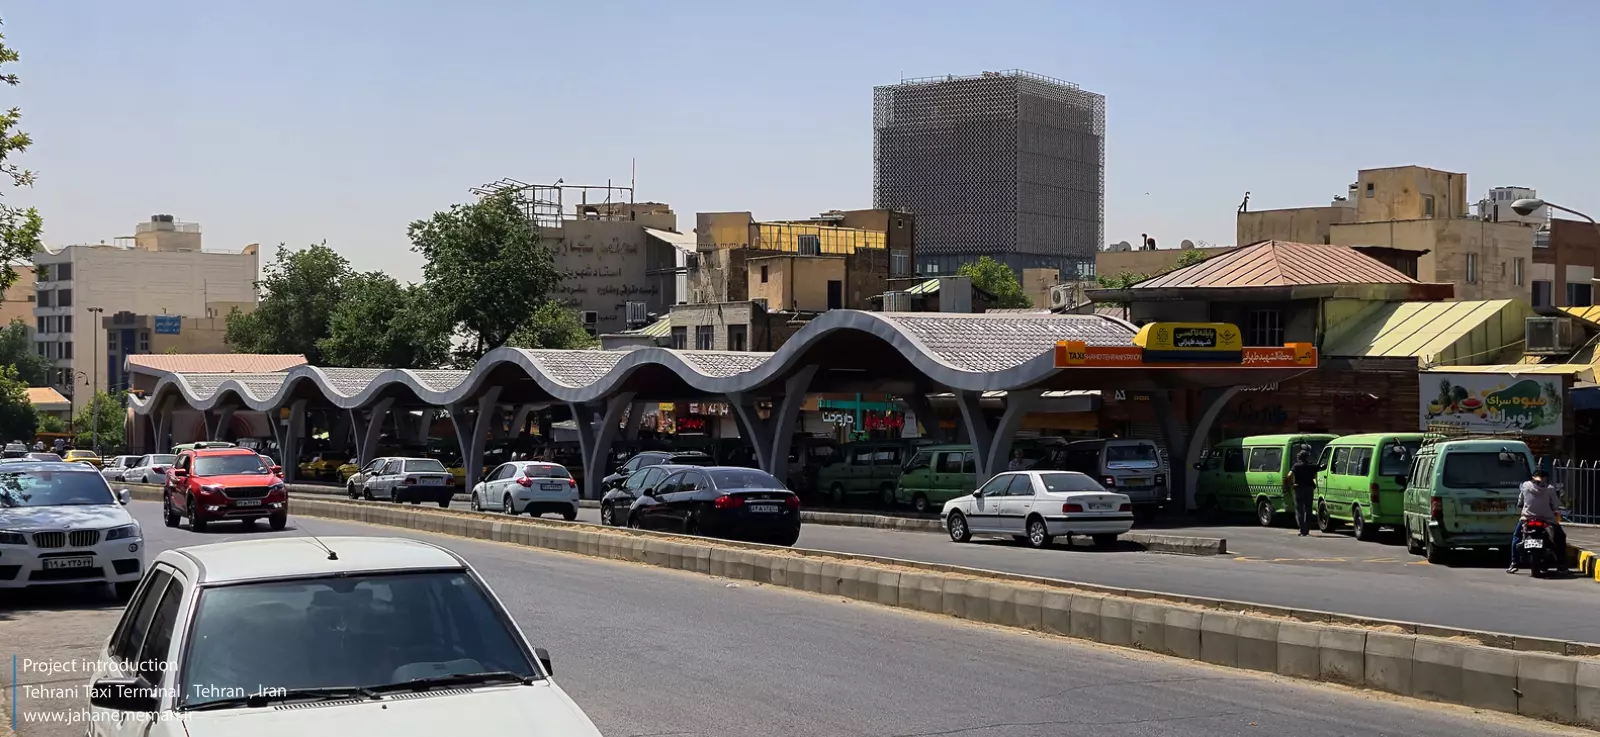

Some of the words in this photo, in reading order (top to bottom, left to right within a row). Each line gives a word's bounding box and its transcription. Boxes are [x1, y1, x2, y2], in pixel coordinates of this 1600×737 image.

[1487, 395, 1511, 407] سرای
[1512, 396, 1546, 409] میوه
[1486, 408, 1532, 428] نوبرانه
